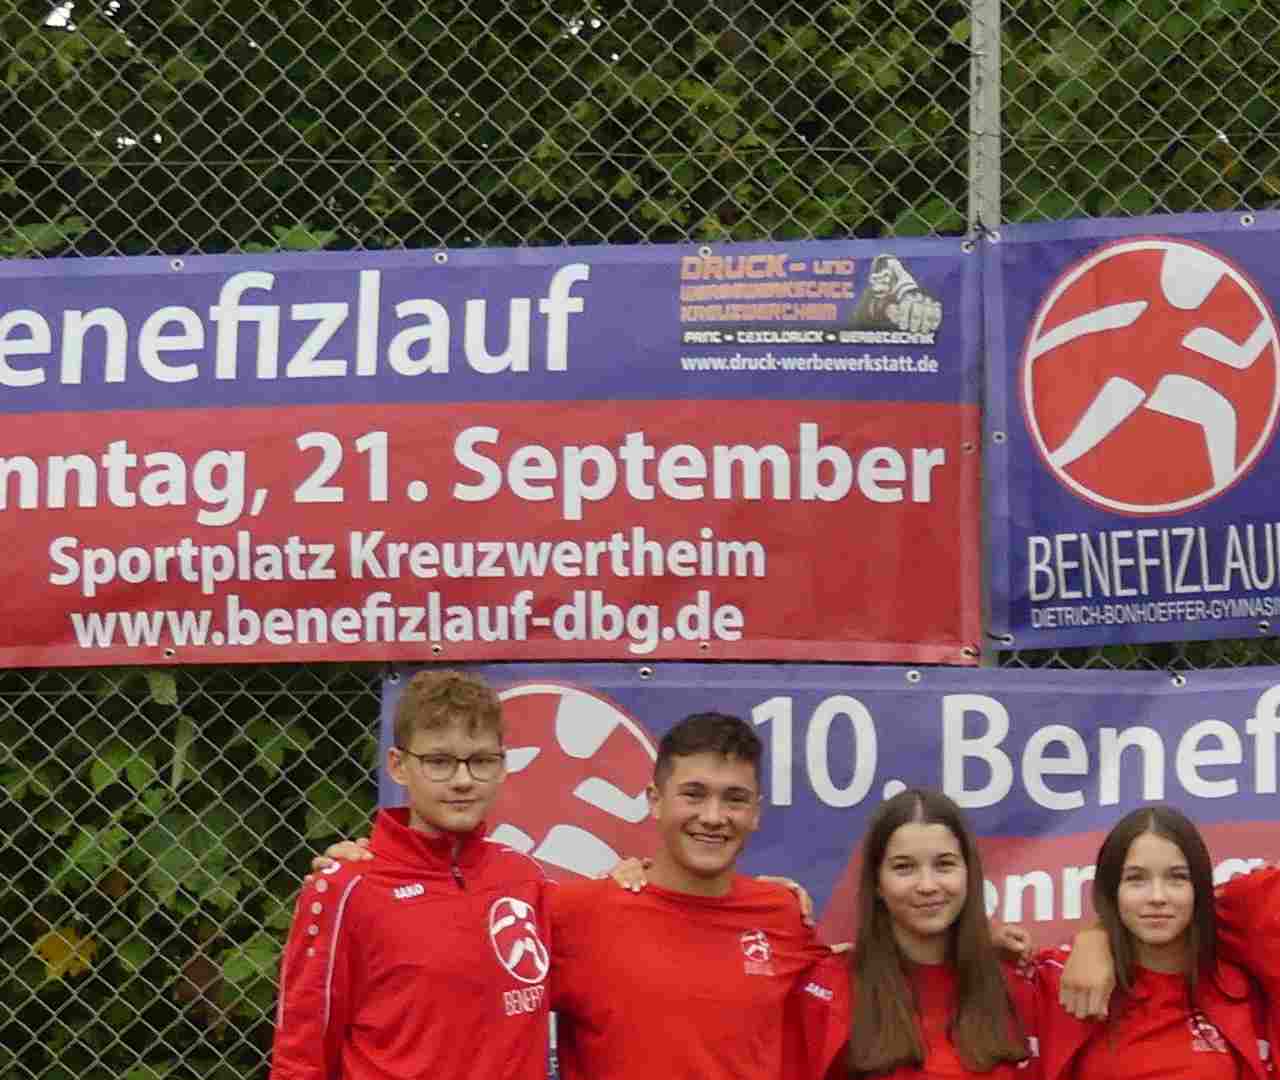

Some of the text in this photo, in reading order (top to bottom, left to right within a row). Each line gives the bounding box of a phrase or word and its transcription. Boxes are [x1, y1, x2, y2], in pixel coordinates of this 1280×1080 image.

[681, 353, 938, 373] www.druck-werbewerkstatt.de
[293, 430, 427, 504] 21.
[452, 422, 947, 521] September
[48, 528, 766, 597] Sportplatz Kreuzwertheim
[70, 588, 744, 655] www.benefizlauf-dbg.de
